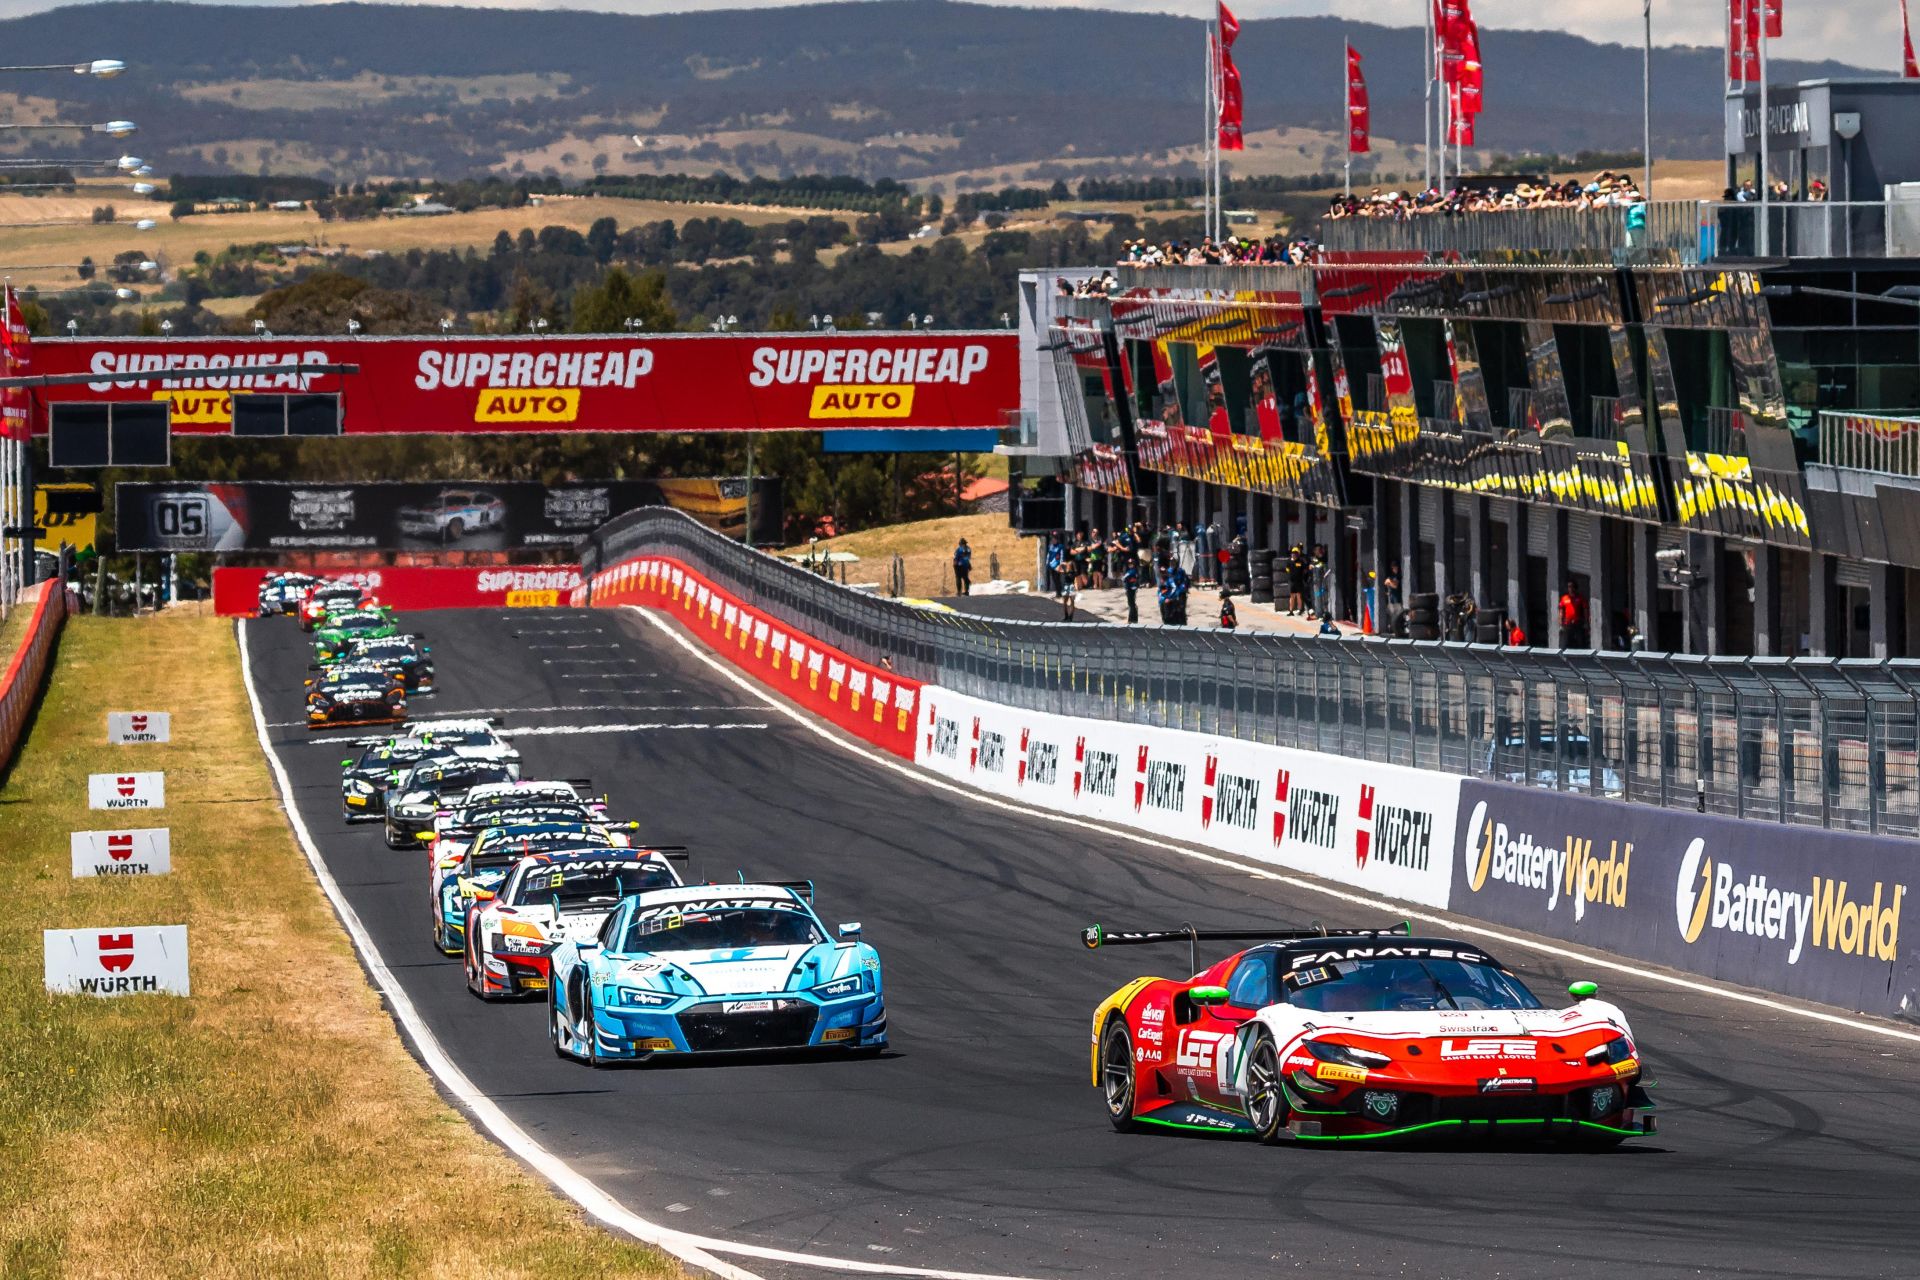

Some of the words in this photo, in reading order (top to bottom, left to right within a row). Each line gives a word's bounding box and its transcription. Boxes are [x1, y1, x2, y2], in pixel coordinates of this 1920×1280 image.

[414, 348, 655, 390] SUPERCHEAP
[748, 344, 989, 387] SUPERCHEAP
[486, 395, 567, 415] AUTO
[820, 391, 901, 411] AUTO
[157, 501, 203, 536] 05
[477, 570, 582, 592] SUPERCHEA
[481, 831, 611, 850] FANATEC
[527, 861, 662, 879] FANATEC
[638, 899, 796, 923] FANATEC
[1086, 926, 1098, 940] aws
[1292, 947, 1482, 969] FANATEC
[1439, 1024, 1493, 1032] Swisstrax
[1439, 1039, 1538, 1057] LEE
[1319, 1066, 1361, 1080] PIRELLI
